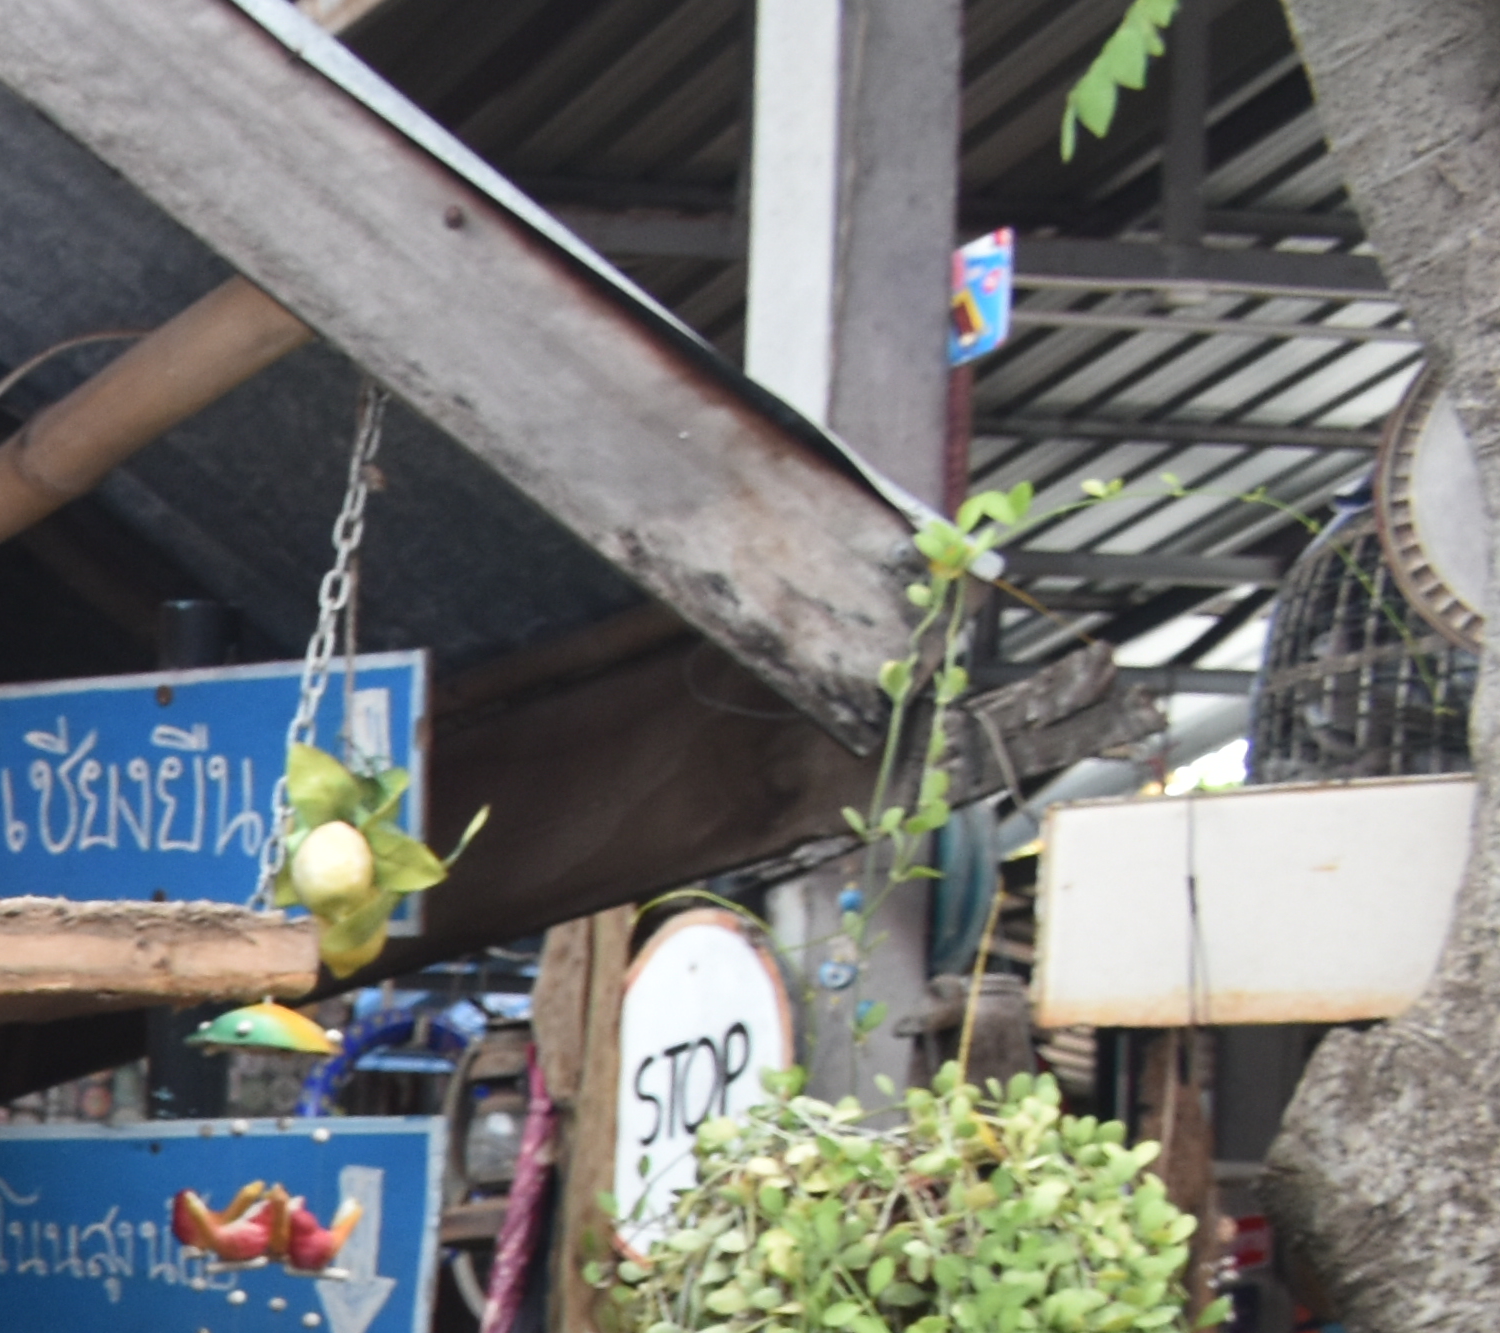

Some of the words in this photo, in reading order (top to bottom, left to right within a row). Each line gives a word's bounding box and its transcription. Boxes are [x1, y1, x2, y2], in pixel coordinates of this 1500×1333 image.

[0, 714, 265, 857] เชียงยืน
[633, 1020, 751, 1147] STOP
